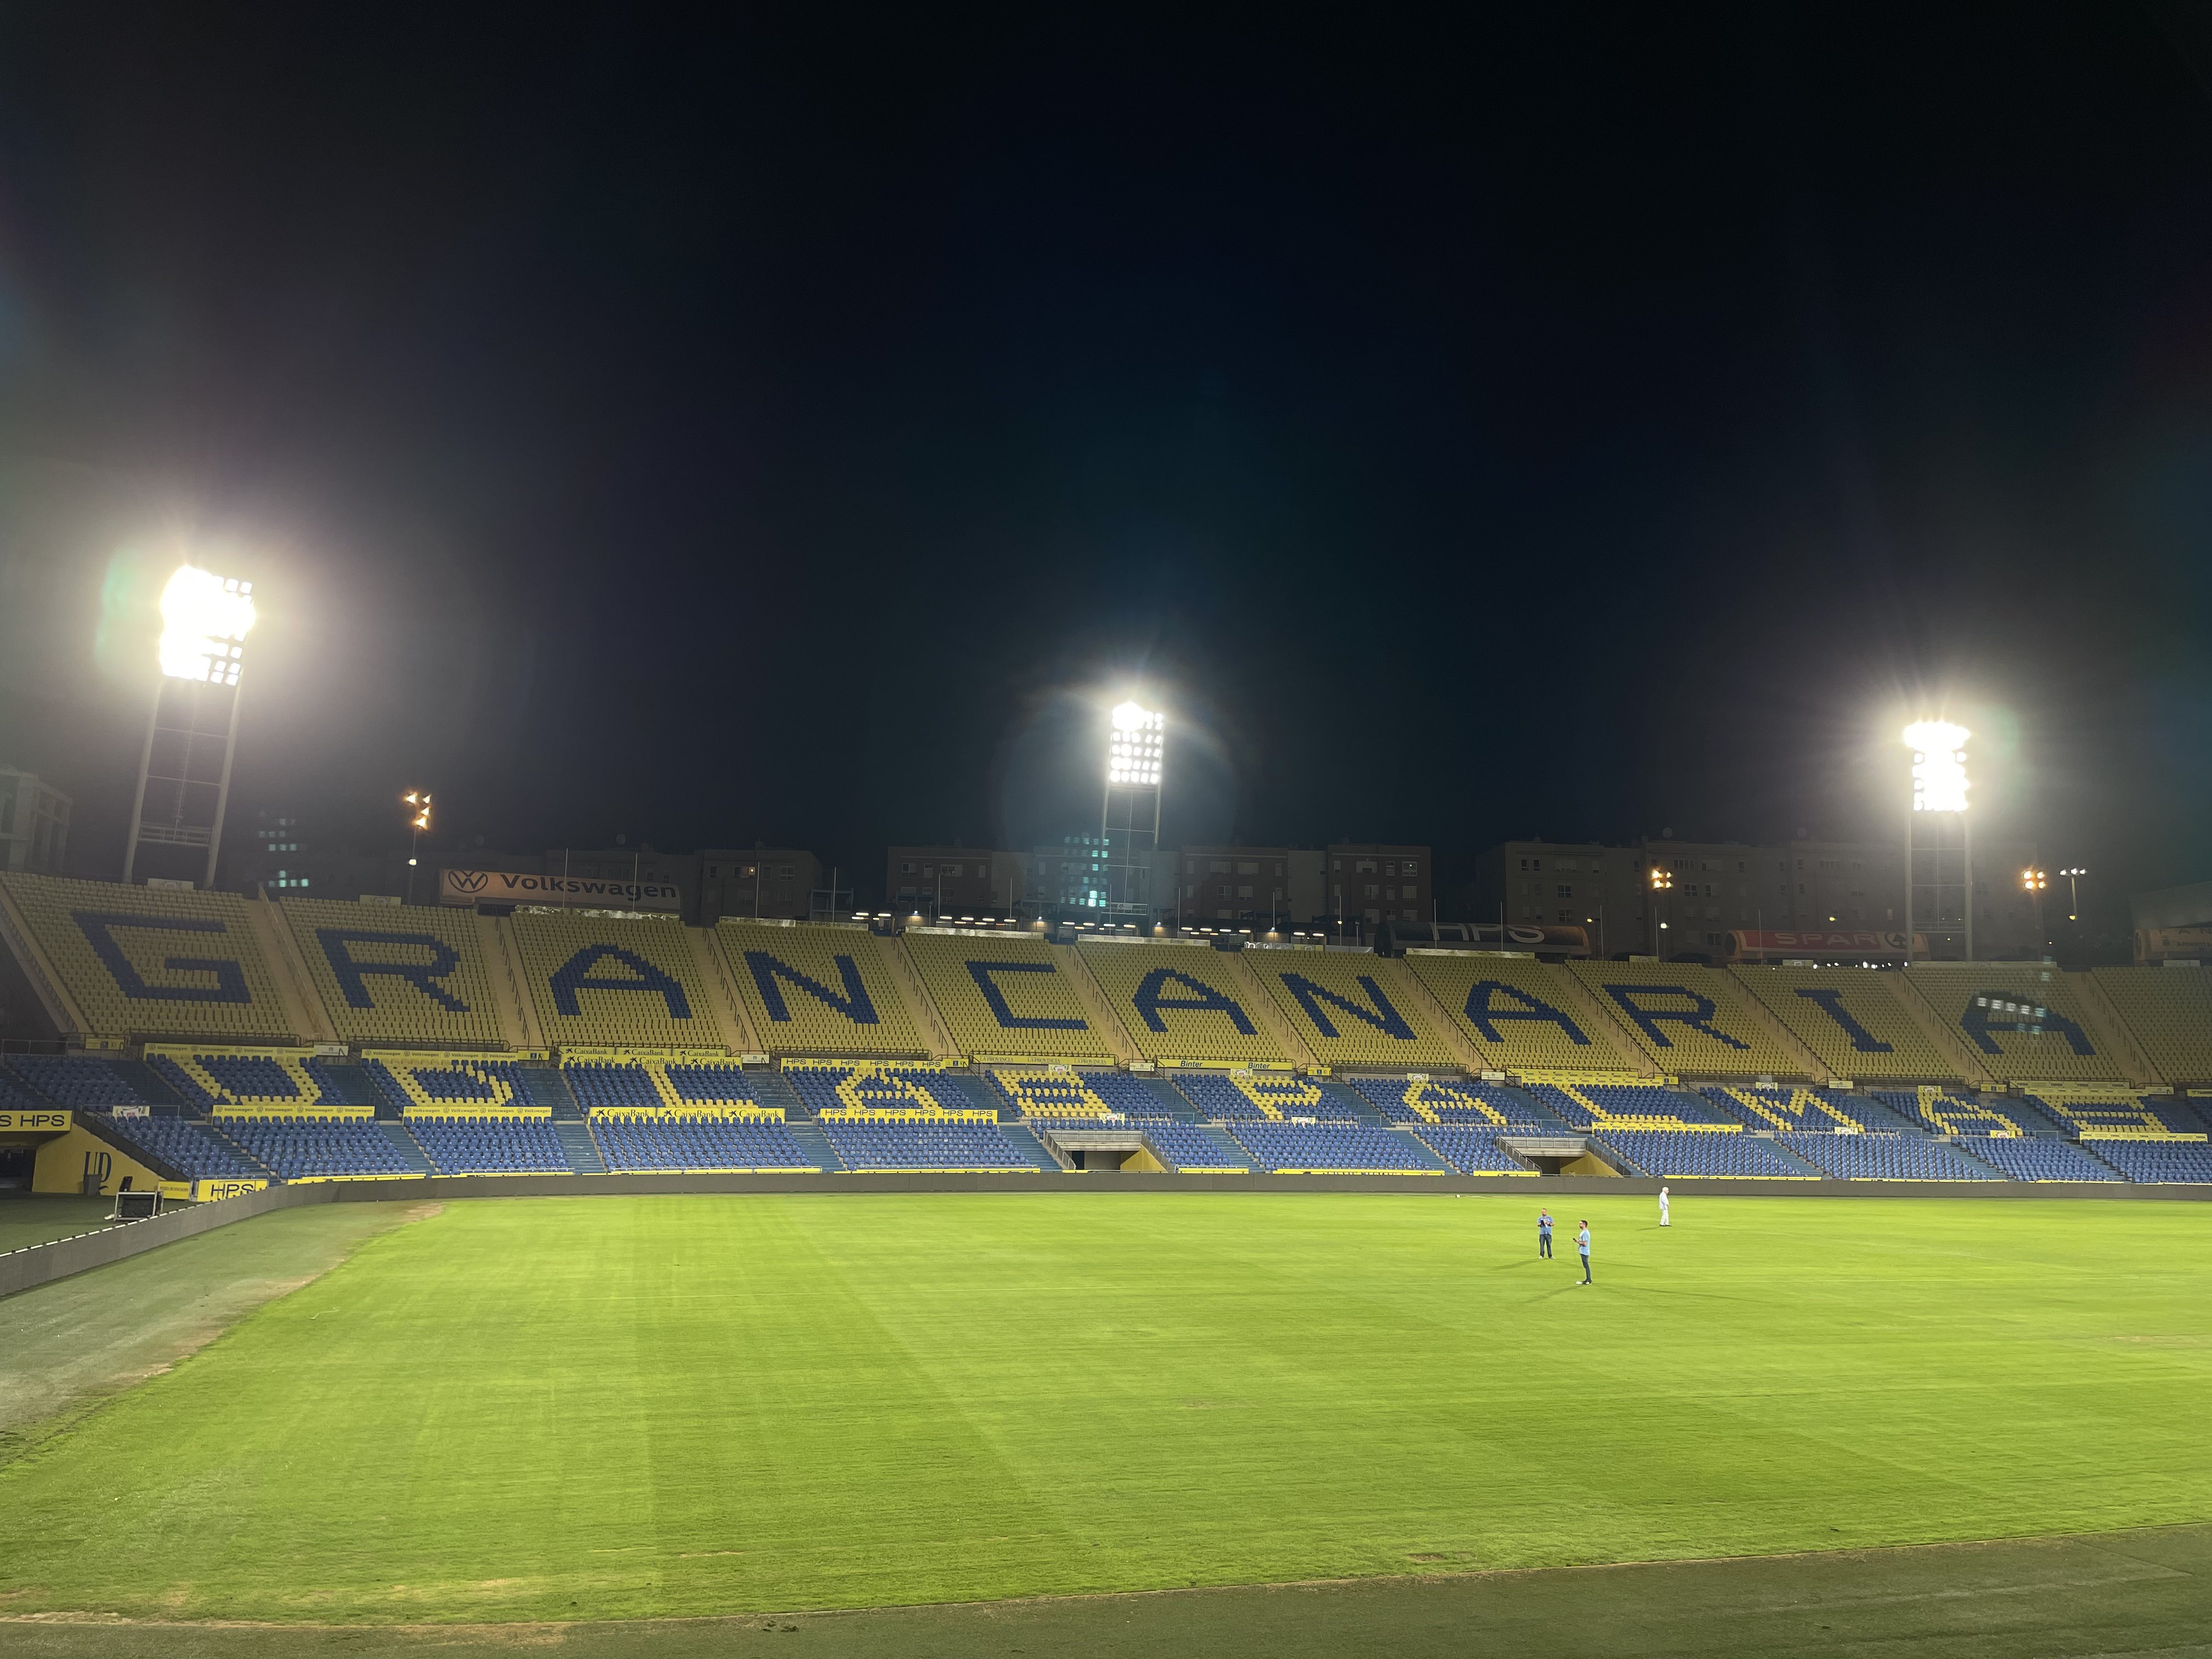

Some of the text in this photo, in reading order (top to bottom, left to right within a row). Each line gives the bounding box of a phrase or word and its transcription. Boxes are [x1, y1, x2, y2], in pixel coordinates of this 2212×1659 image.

[500, 873, 676, 901] Volkswagen
[1427, 922, 1545, 944] HPS
[1774, 932, 1878, 946] SPAR
[74, 910, 879, 1025] GRAN
[20, 1115, 65, 1127] HPS
[674, 1109, 715, 1118] CaixaBank
[83, 1151, 112, 1190] UD
[210, 1183, 254, 1199] HPS
